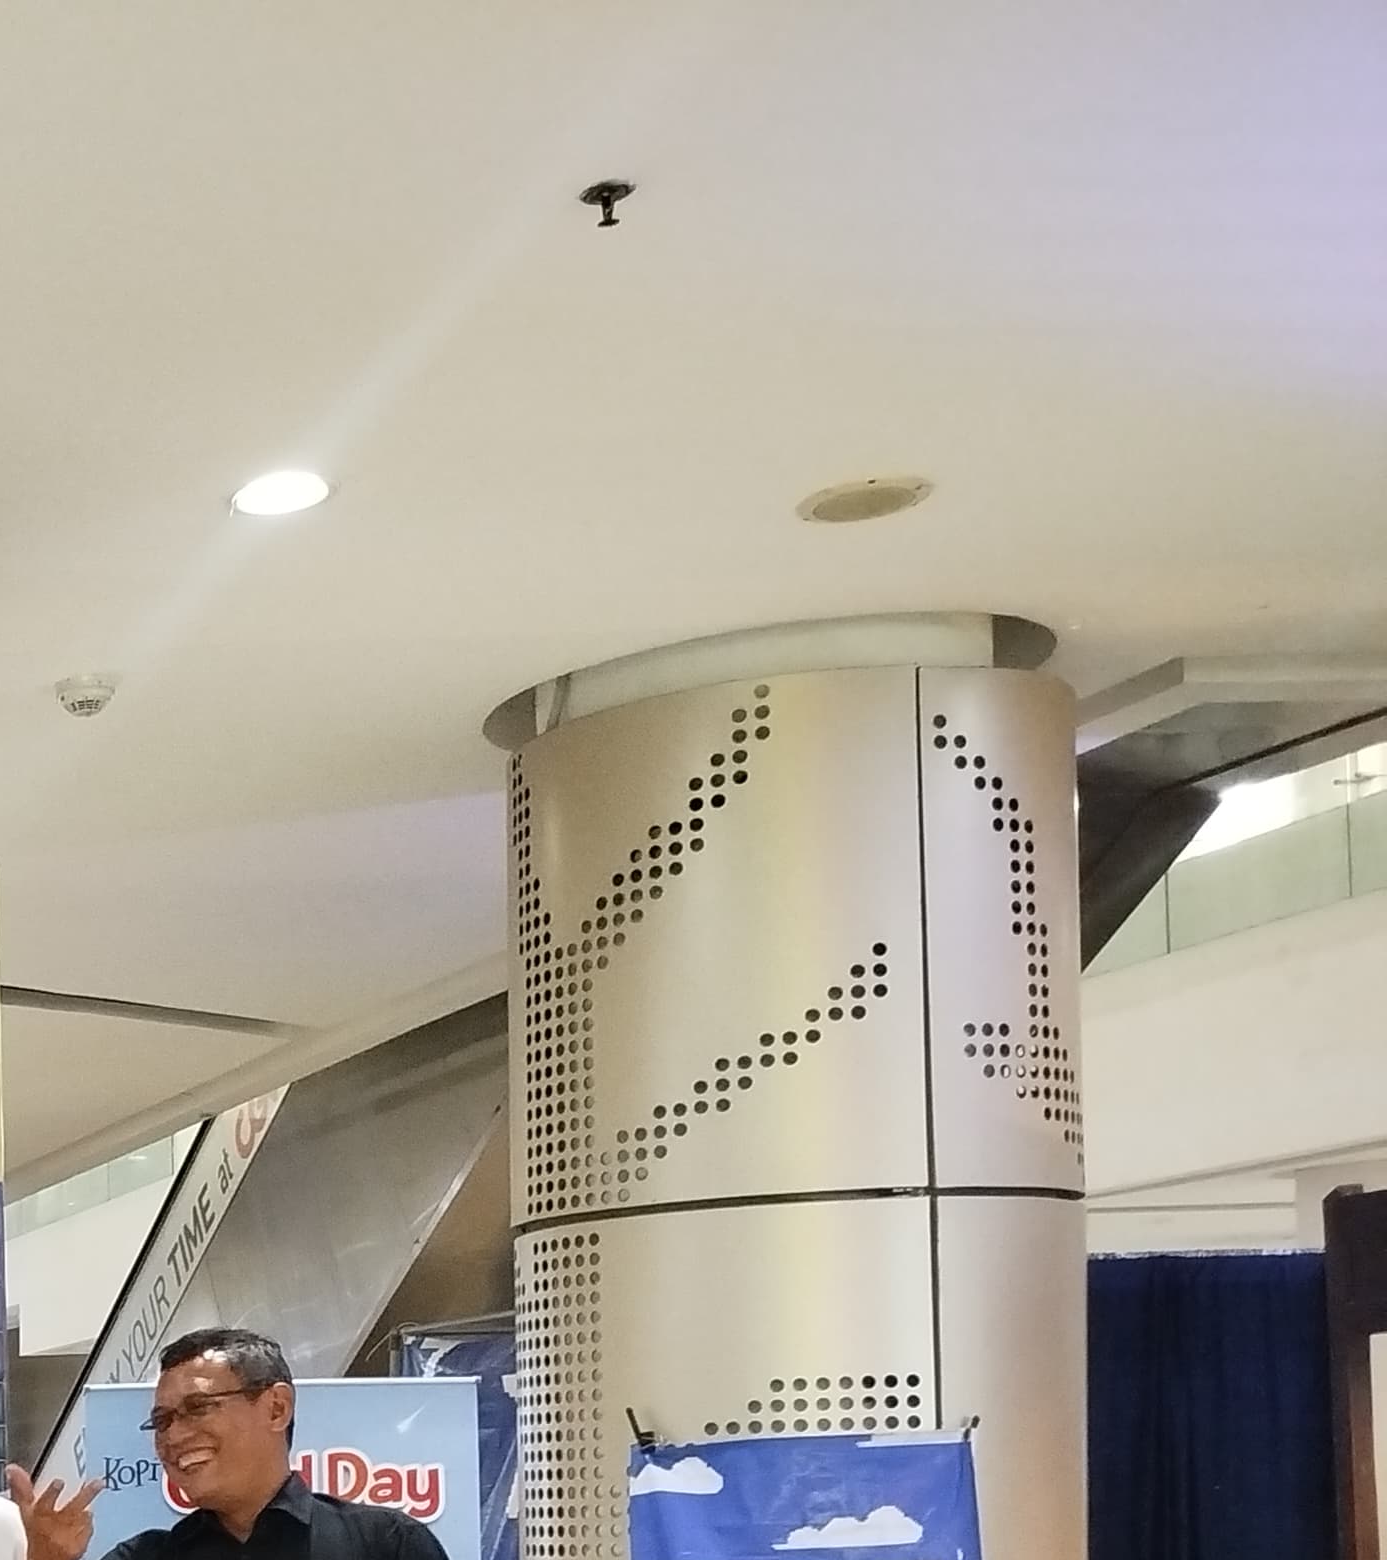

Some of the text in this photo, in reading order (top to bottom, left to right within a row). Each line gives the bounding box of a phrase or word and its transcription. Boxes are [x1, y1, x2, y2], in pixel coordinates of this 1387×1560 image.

[119, 1275, 171, 1372] YOUR
[167, 1181, 216, 1287] TIME
[326, 1450, 443, 1520] Day
